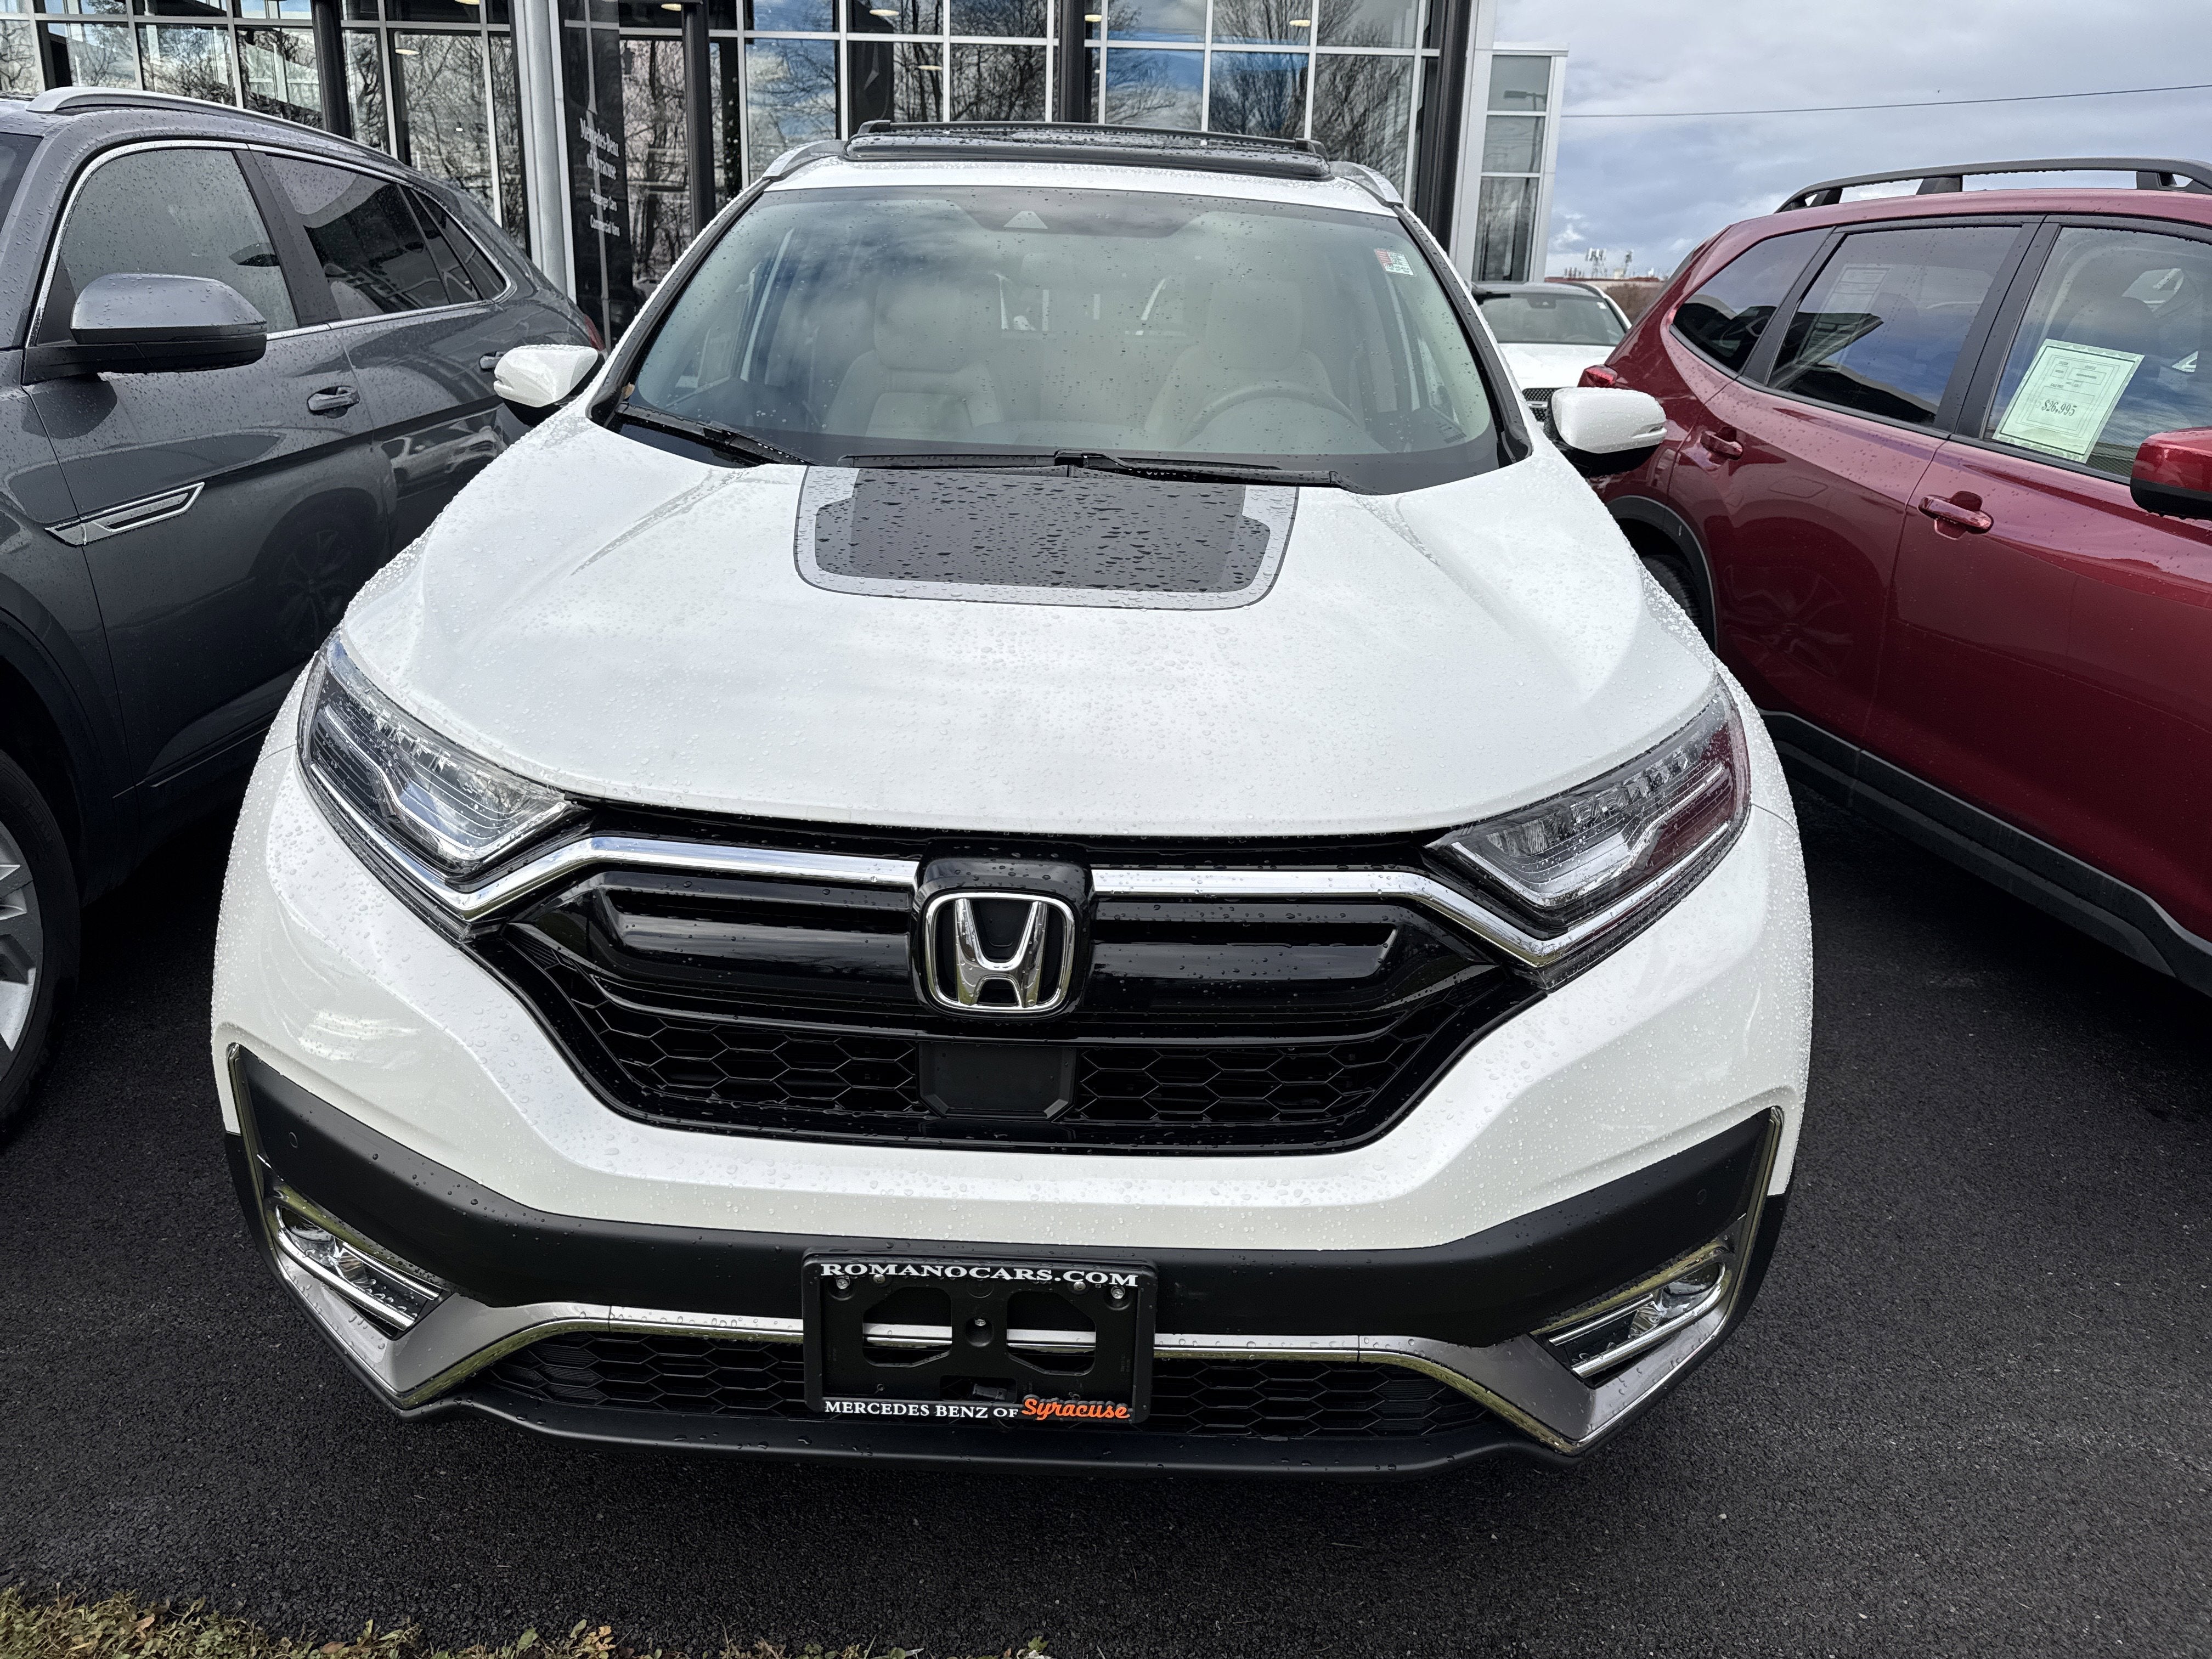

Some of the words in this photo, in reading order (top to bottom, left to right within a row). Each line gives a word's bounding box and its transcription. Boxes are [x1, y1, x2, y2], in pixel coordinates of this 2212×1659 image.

[580, 117, 619, 157] Mercedes-Benz
[2041, 399, 2077, 416] $26,995
[820, 1263, 1138, 1287] ROMANOCARS.COM
[825, 1401, 929, 1416] MERCEDES
[935, 1405, 988, 1418] BENZ
[994, 1407, 1019, 1418] OF
[1022, 1398, 1130, 1420] Syracuse
